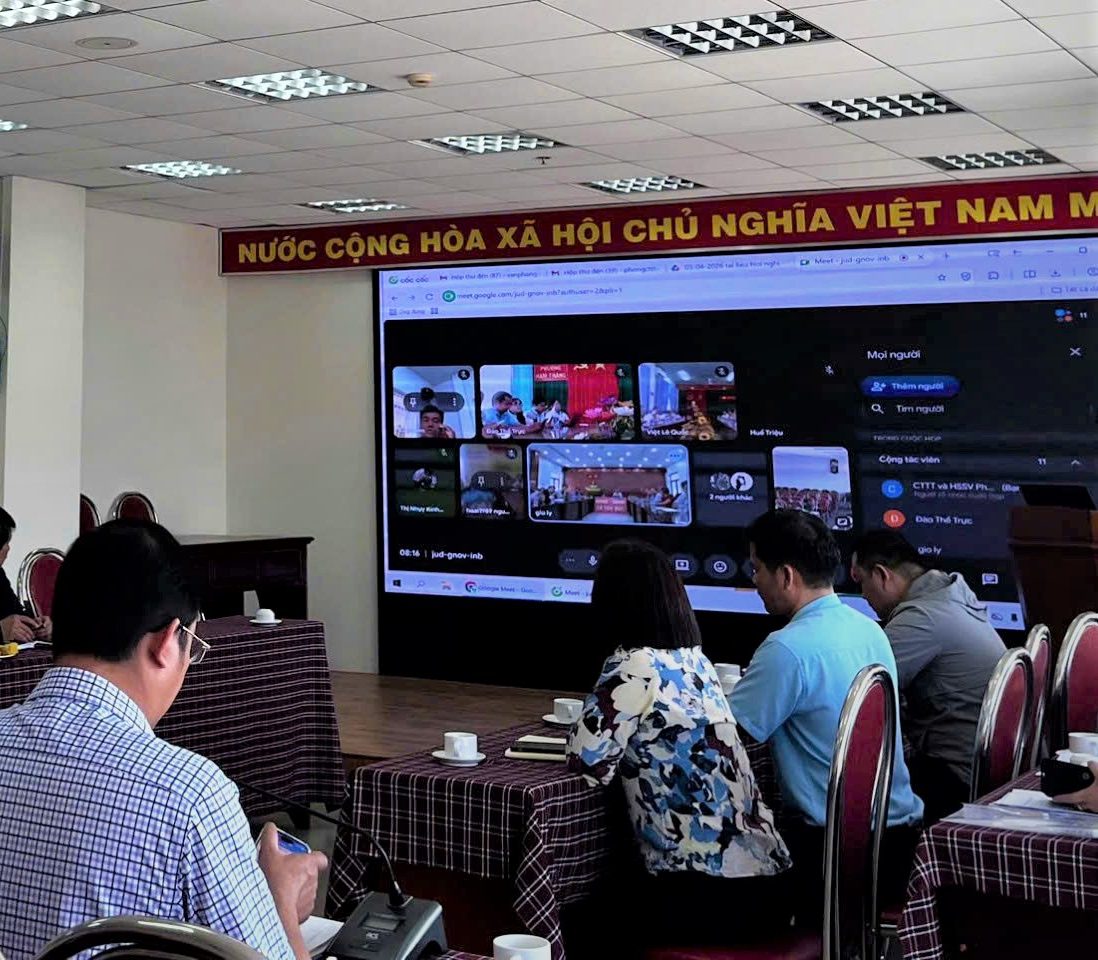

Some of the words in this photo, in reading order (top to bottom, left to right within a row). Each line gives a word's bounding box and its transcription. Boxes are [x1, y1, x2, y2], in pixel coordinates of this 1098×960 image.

[238, 234, 317, 264] NƯỚC
[325, 232, 410, 263] CỘNG
[420, 224, 487, 253] HÒA
[496, 219, 541, 249] XÃ
[552, 217, 612, 252] HỘI
[623, 207, 699, 243] CHỦ
[712, 201, 836, 237] NGHĨA
[846, 196, 942, 235] VIỆT
[956, 193, 1054, 224] NAM
[867, 349, 888, 360] Mọi
[889, 348, 921, 361] người
[892, 381, 917, 391] Thêm
[917, 381, 944, 392] người
[915, 403, 945, 415] người
[879, 455, 903, 465] Cộng
[921, 455, 941, 464] viên
[912, 481, 936, 491] CTTT
[949, 482, 974, 491] HSSV
[399, 548, 421, 557] 08:16
